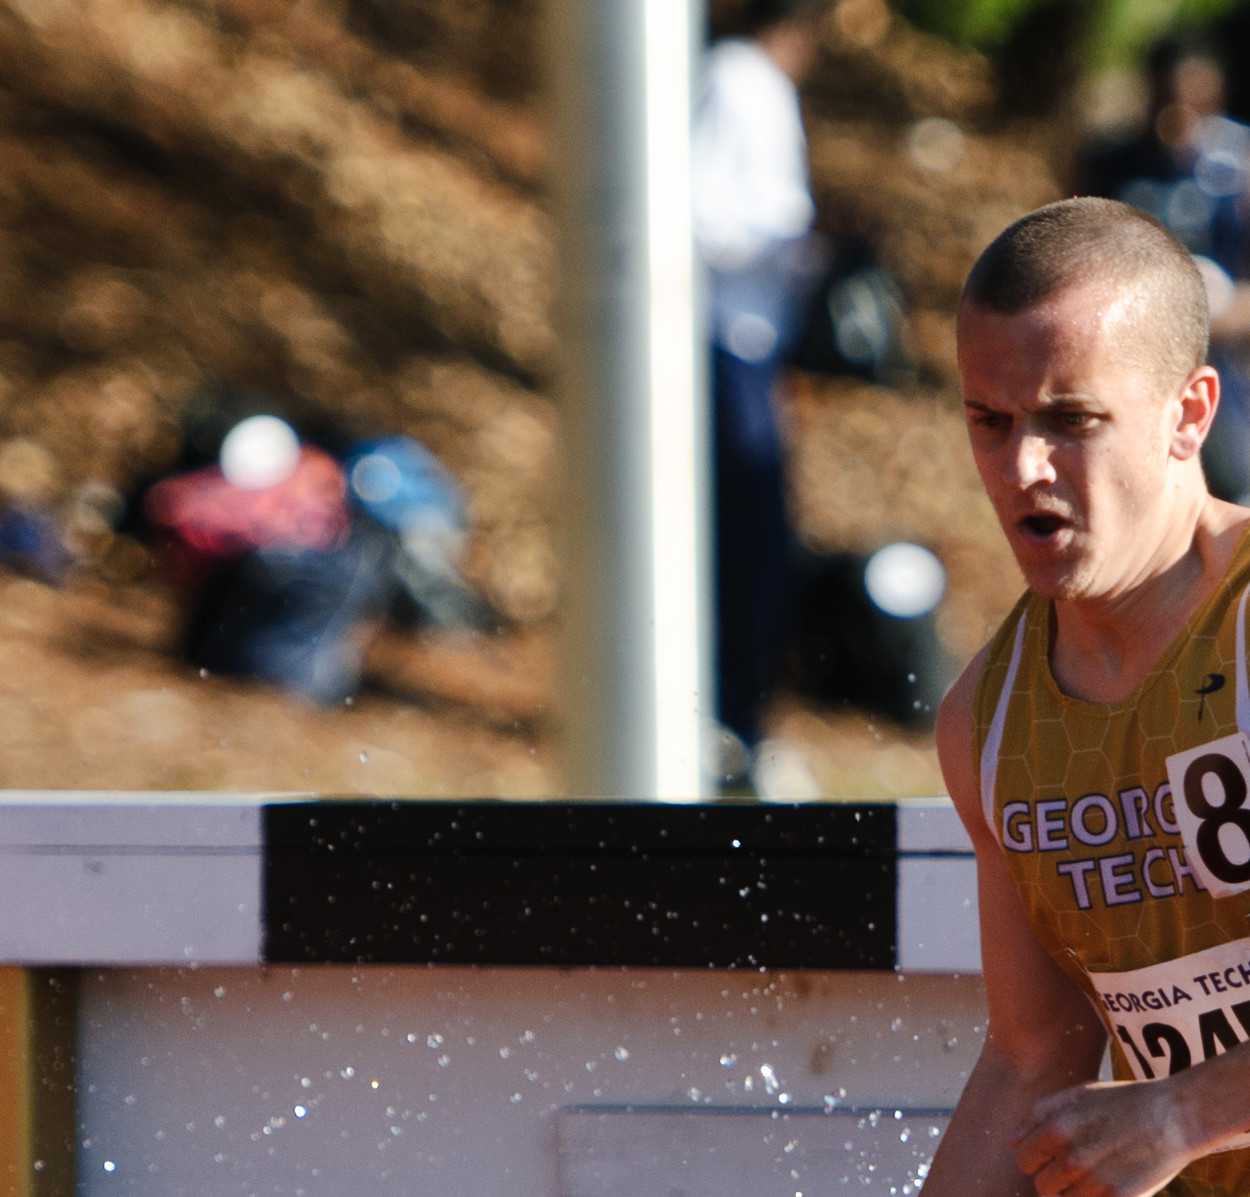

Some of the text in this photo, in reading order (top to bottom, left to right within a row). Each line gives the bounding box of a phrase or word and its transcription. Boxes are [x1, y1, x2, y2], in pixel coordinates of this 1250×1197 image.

[1003, 782, 1182, 853] GEORG
[1057, 846, 1208, 910] TECH
[1100, 985, 1193, 1013] EORGIA
